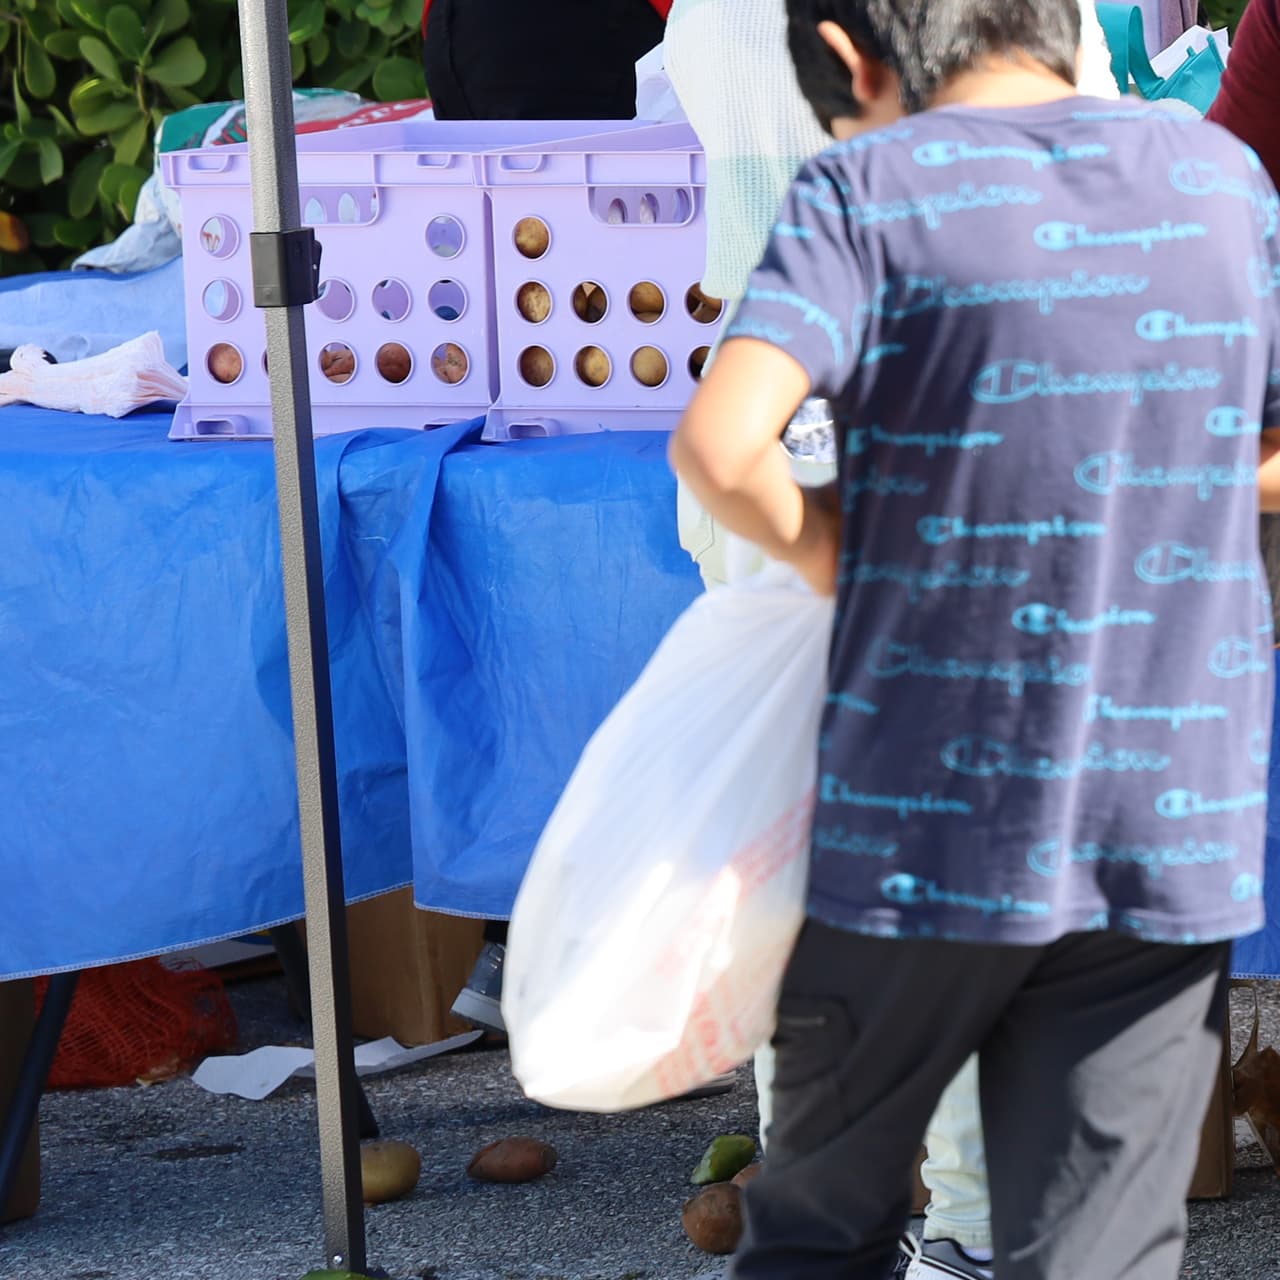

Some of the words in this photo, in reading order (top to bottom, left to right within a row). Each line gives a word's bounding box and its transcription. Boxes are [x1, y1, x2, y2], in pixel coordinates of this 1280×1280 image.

[1033, 220, 1207, 252] Champion
[969, 358, 1222, 407] Champion
[916, 515, 1106, 546] Champion
